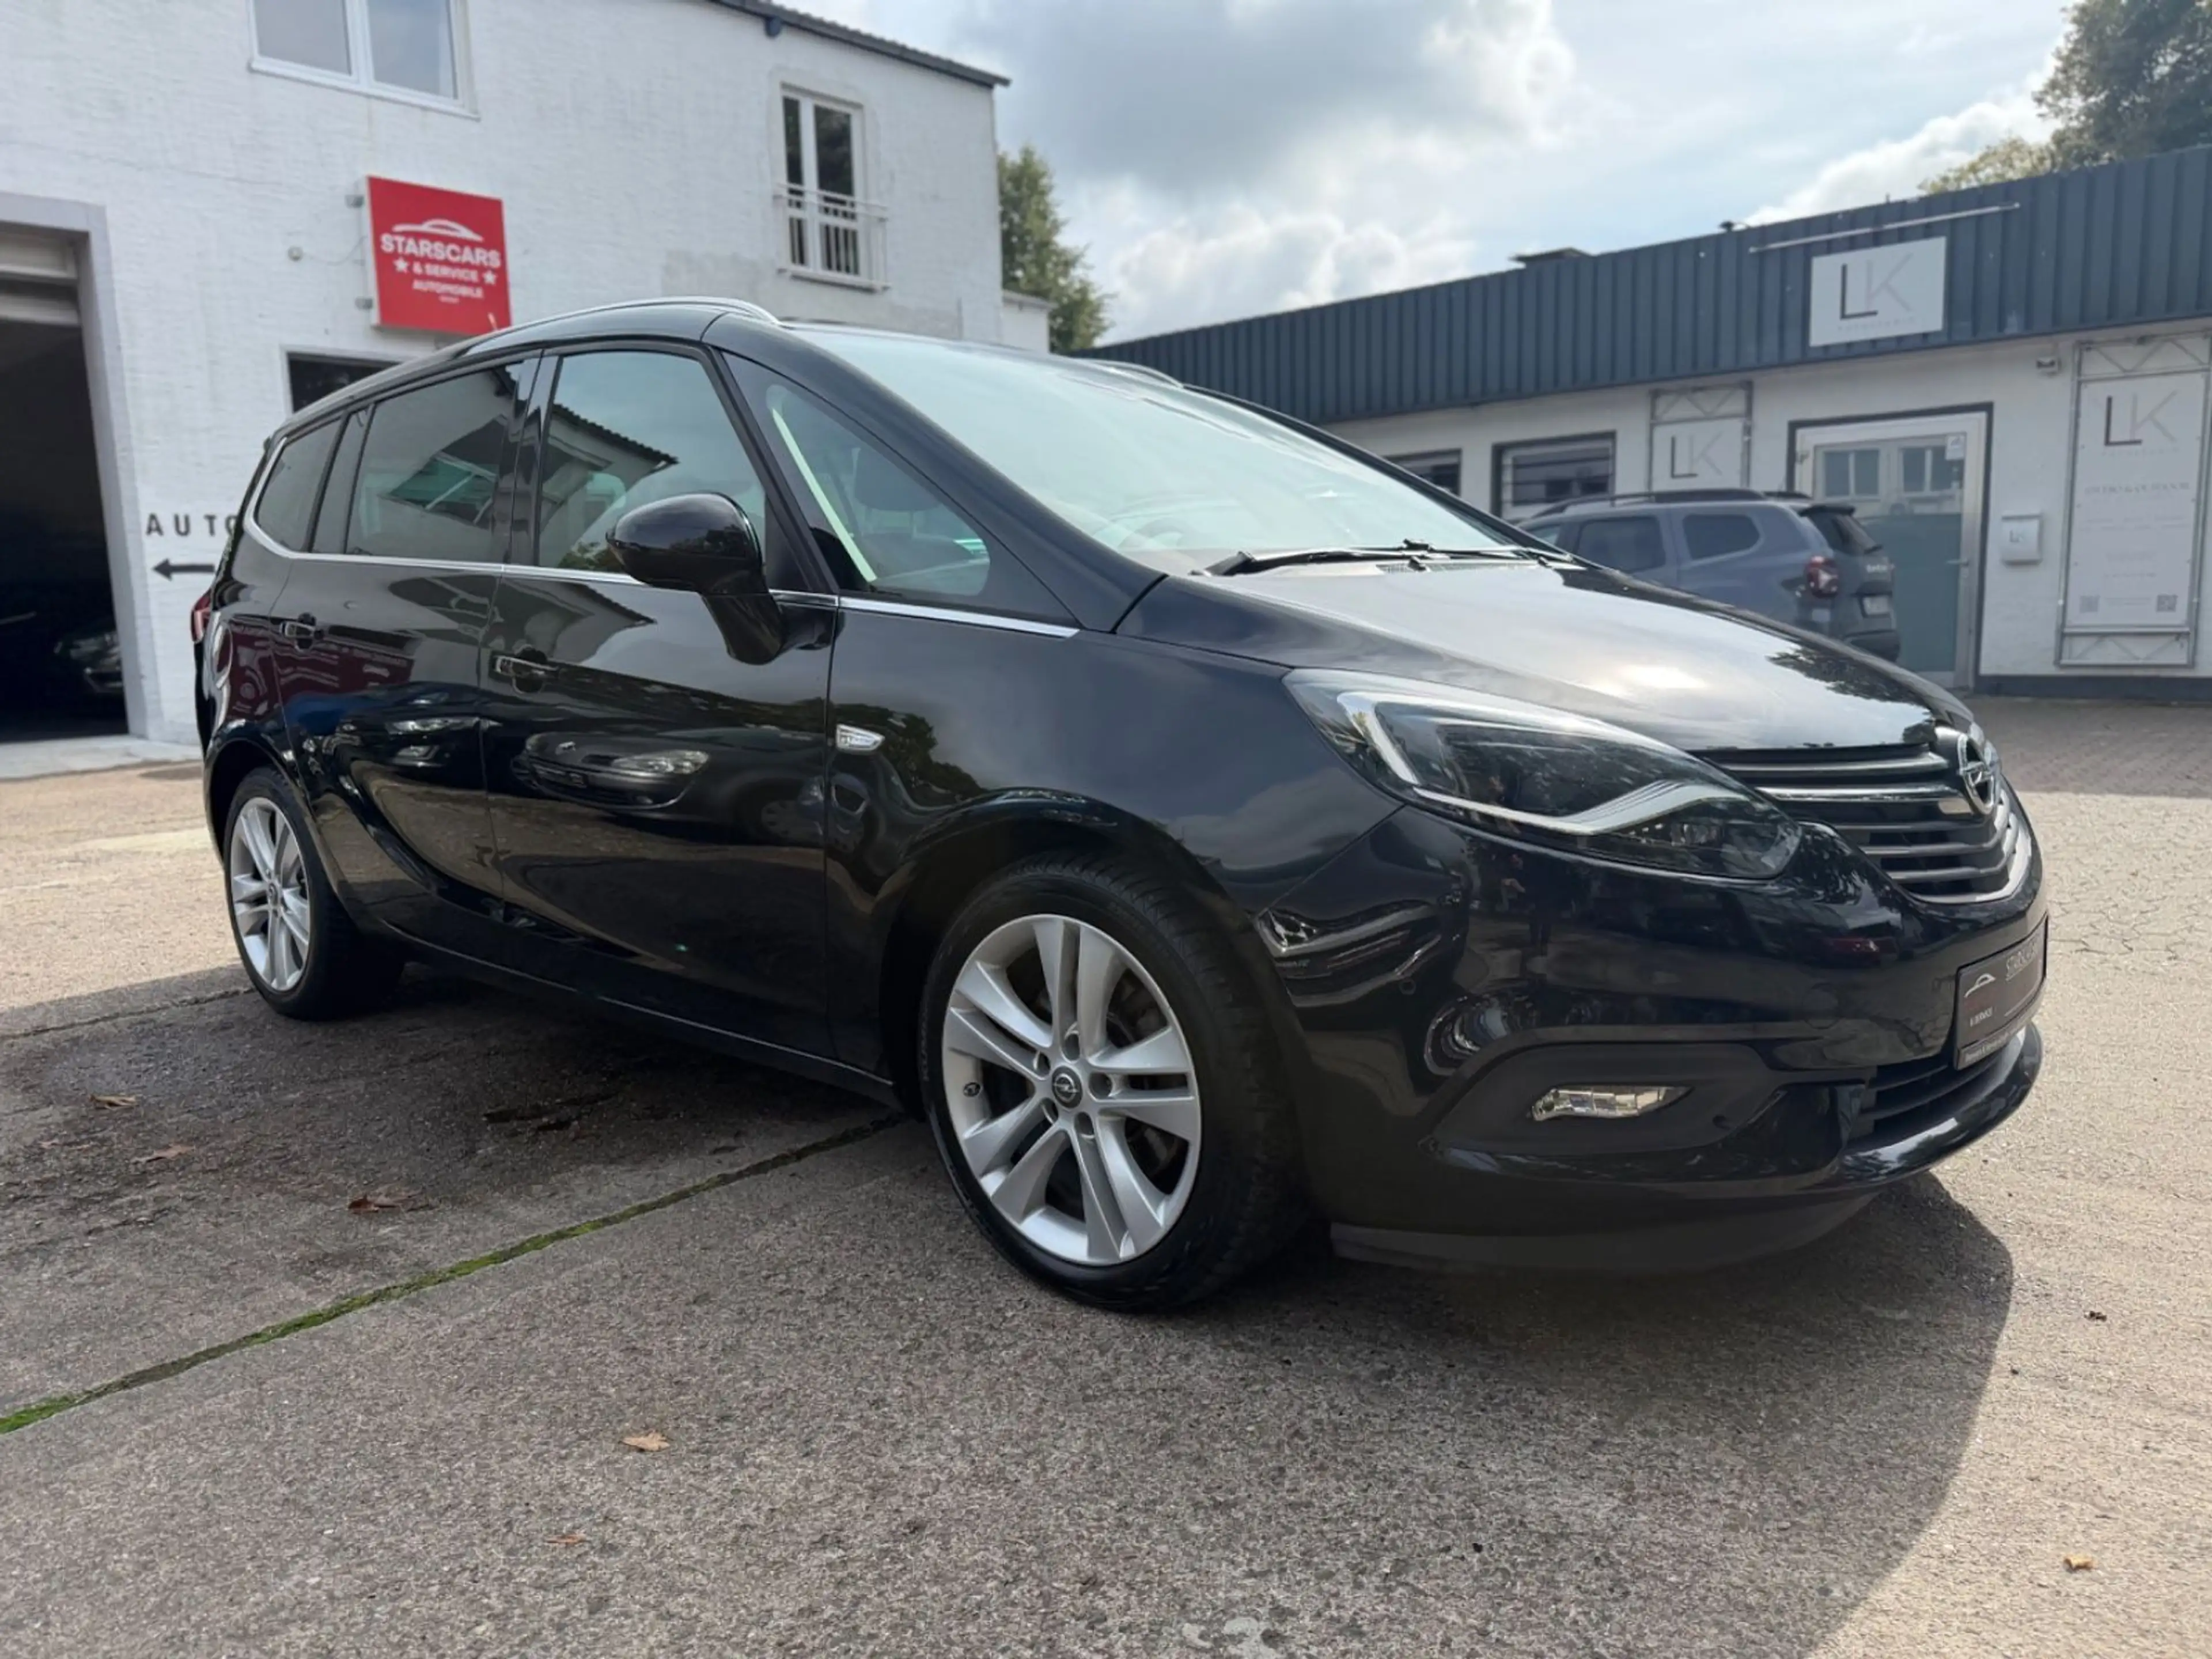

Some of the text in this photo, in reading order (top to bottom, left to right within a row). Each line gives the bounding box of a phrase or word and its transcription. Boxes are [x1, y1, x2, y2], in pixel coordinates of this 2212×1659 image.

[380, 232, 501, 268] STARSCARS
[424, 263, 479, 282] SERVICE
[1839, 252, 1914, 321] LK
[2104, 389, 2178, 446] LK
